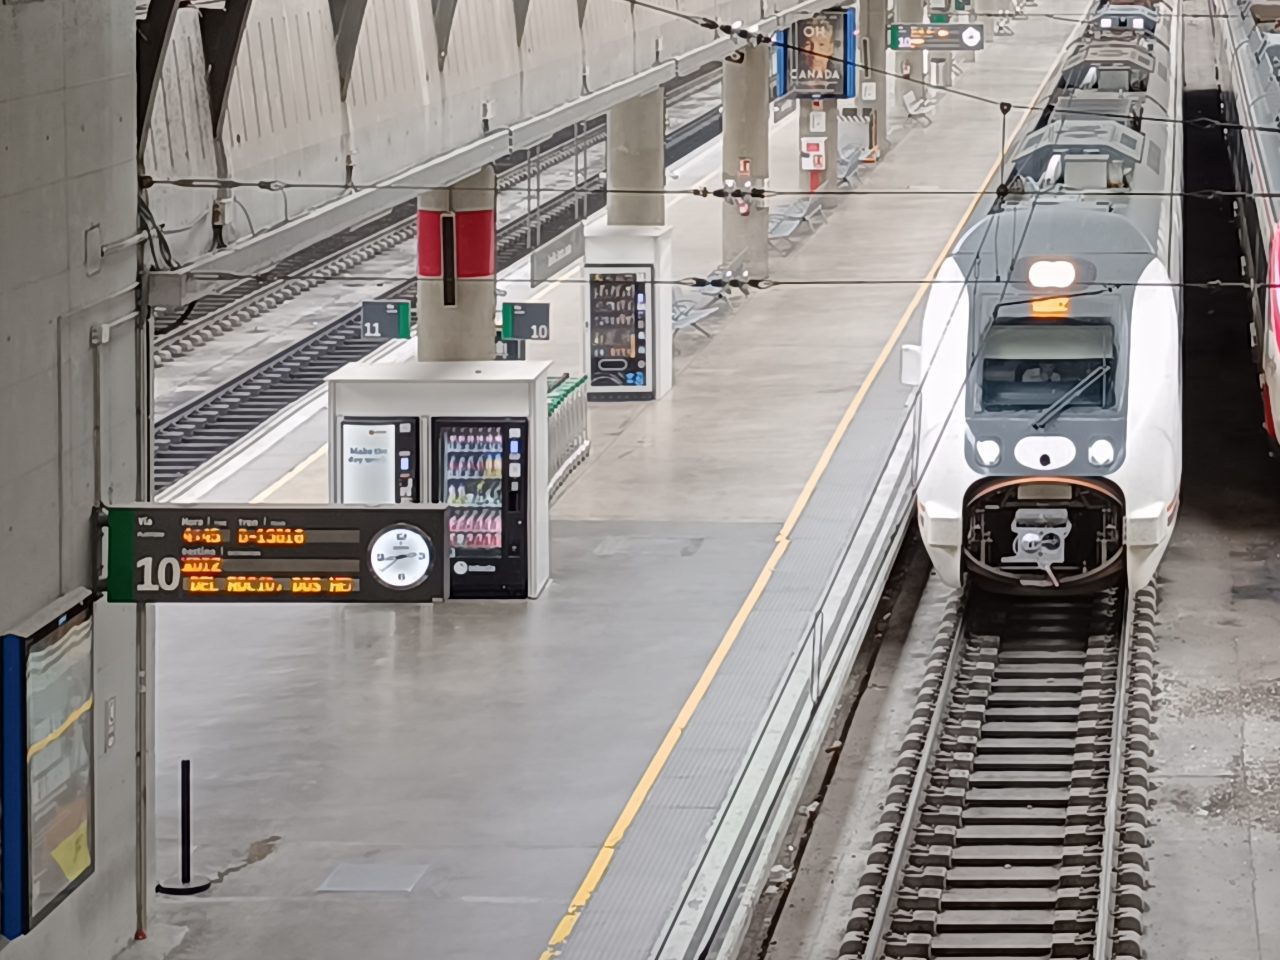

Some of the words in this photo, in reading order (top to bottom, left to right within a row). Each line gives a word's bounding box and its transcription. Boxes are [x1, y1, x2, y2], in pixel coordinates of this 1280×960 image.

[803, 26, 826, 38] OH
[791, 69, 840, 79] CANADA
[364, 322, 381, 337] 11
[530, 324, 548, 339] 10
[136, 556, 181, 591] 10
